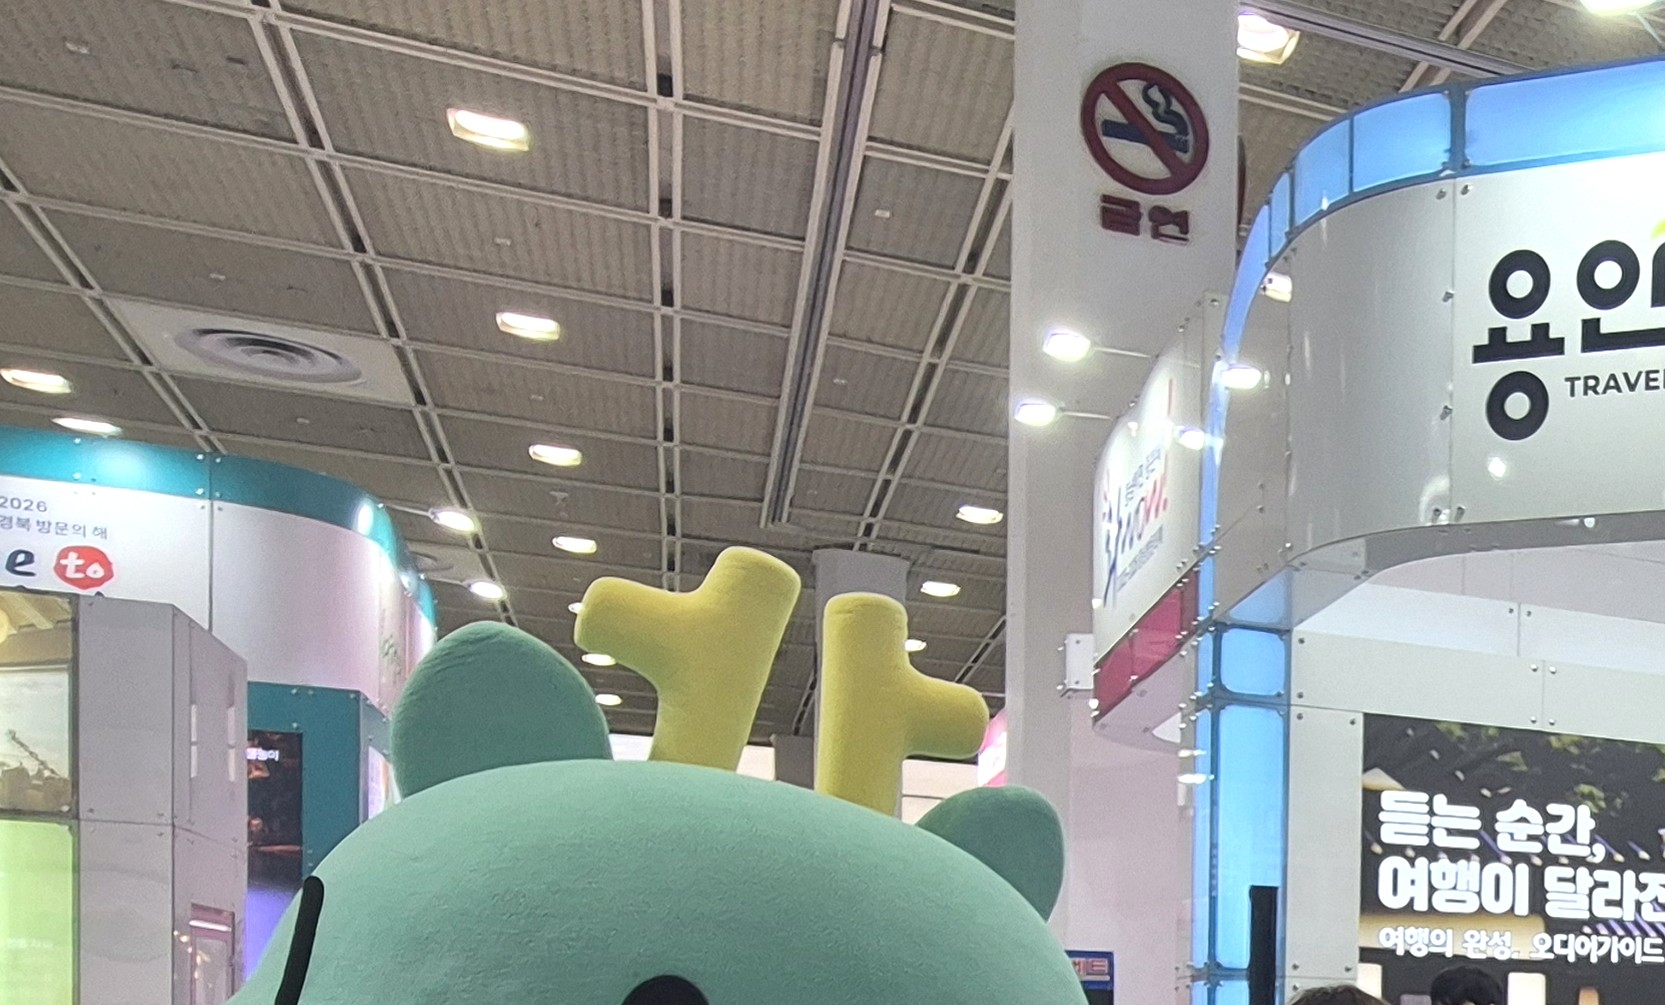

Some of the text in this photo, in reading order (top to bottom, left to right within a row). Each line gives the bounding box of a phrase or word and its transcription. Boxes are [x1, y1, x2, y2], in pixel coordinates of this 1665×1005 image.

[1101, 194, 1190, 241] 금연
[0, 496, 47, 512] 2026
[1378, 789, 1606, 863] 듣는 순간,
[1378, 855, 1529, 916] 여행이
[1379, 926, 1453, 957] 여행의
